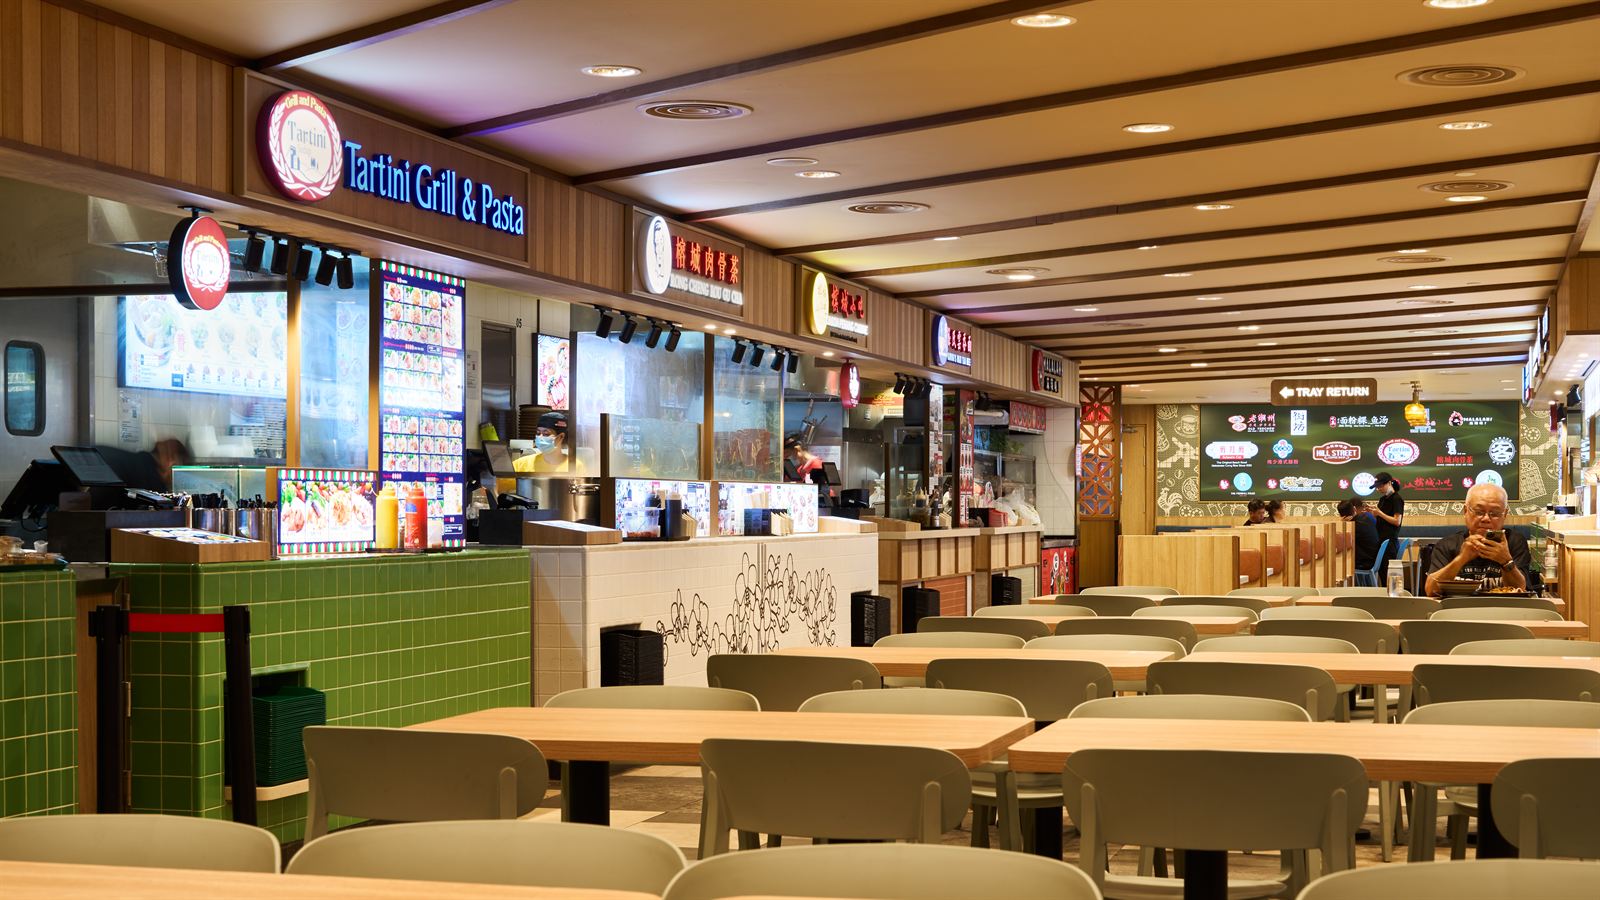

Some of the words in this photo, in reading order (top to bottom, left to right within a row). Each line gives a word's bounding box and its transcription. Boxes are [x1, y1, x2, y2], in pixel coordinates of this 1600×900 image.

[285, 94, 298, 109] Grill
[298, 96, 310, 106] and
[310, 97, 327, 119] Pasta
[287, 120, 326, 149] Tartini
[344, 141, 410, 203] Tartini
[415, 165, 456, 216] Grill
[461, 178, 476, 221] &
[481, 184, 524, 235] Pasta
[1296, 387, 1324, 397] TRAY
[1326, 387, 1369, 396] RETURN
[1316, 449, 1330, 457] HILL
[1332, 449, 1357, 457] STREET
